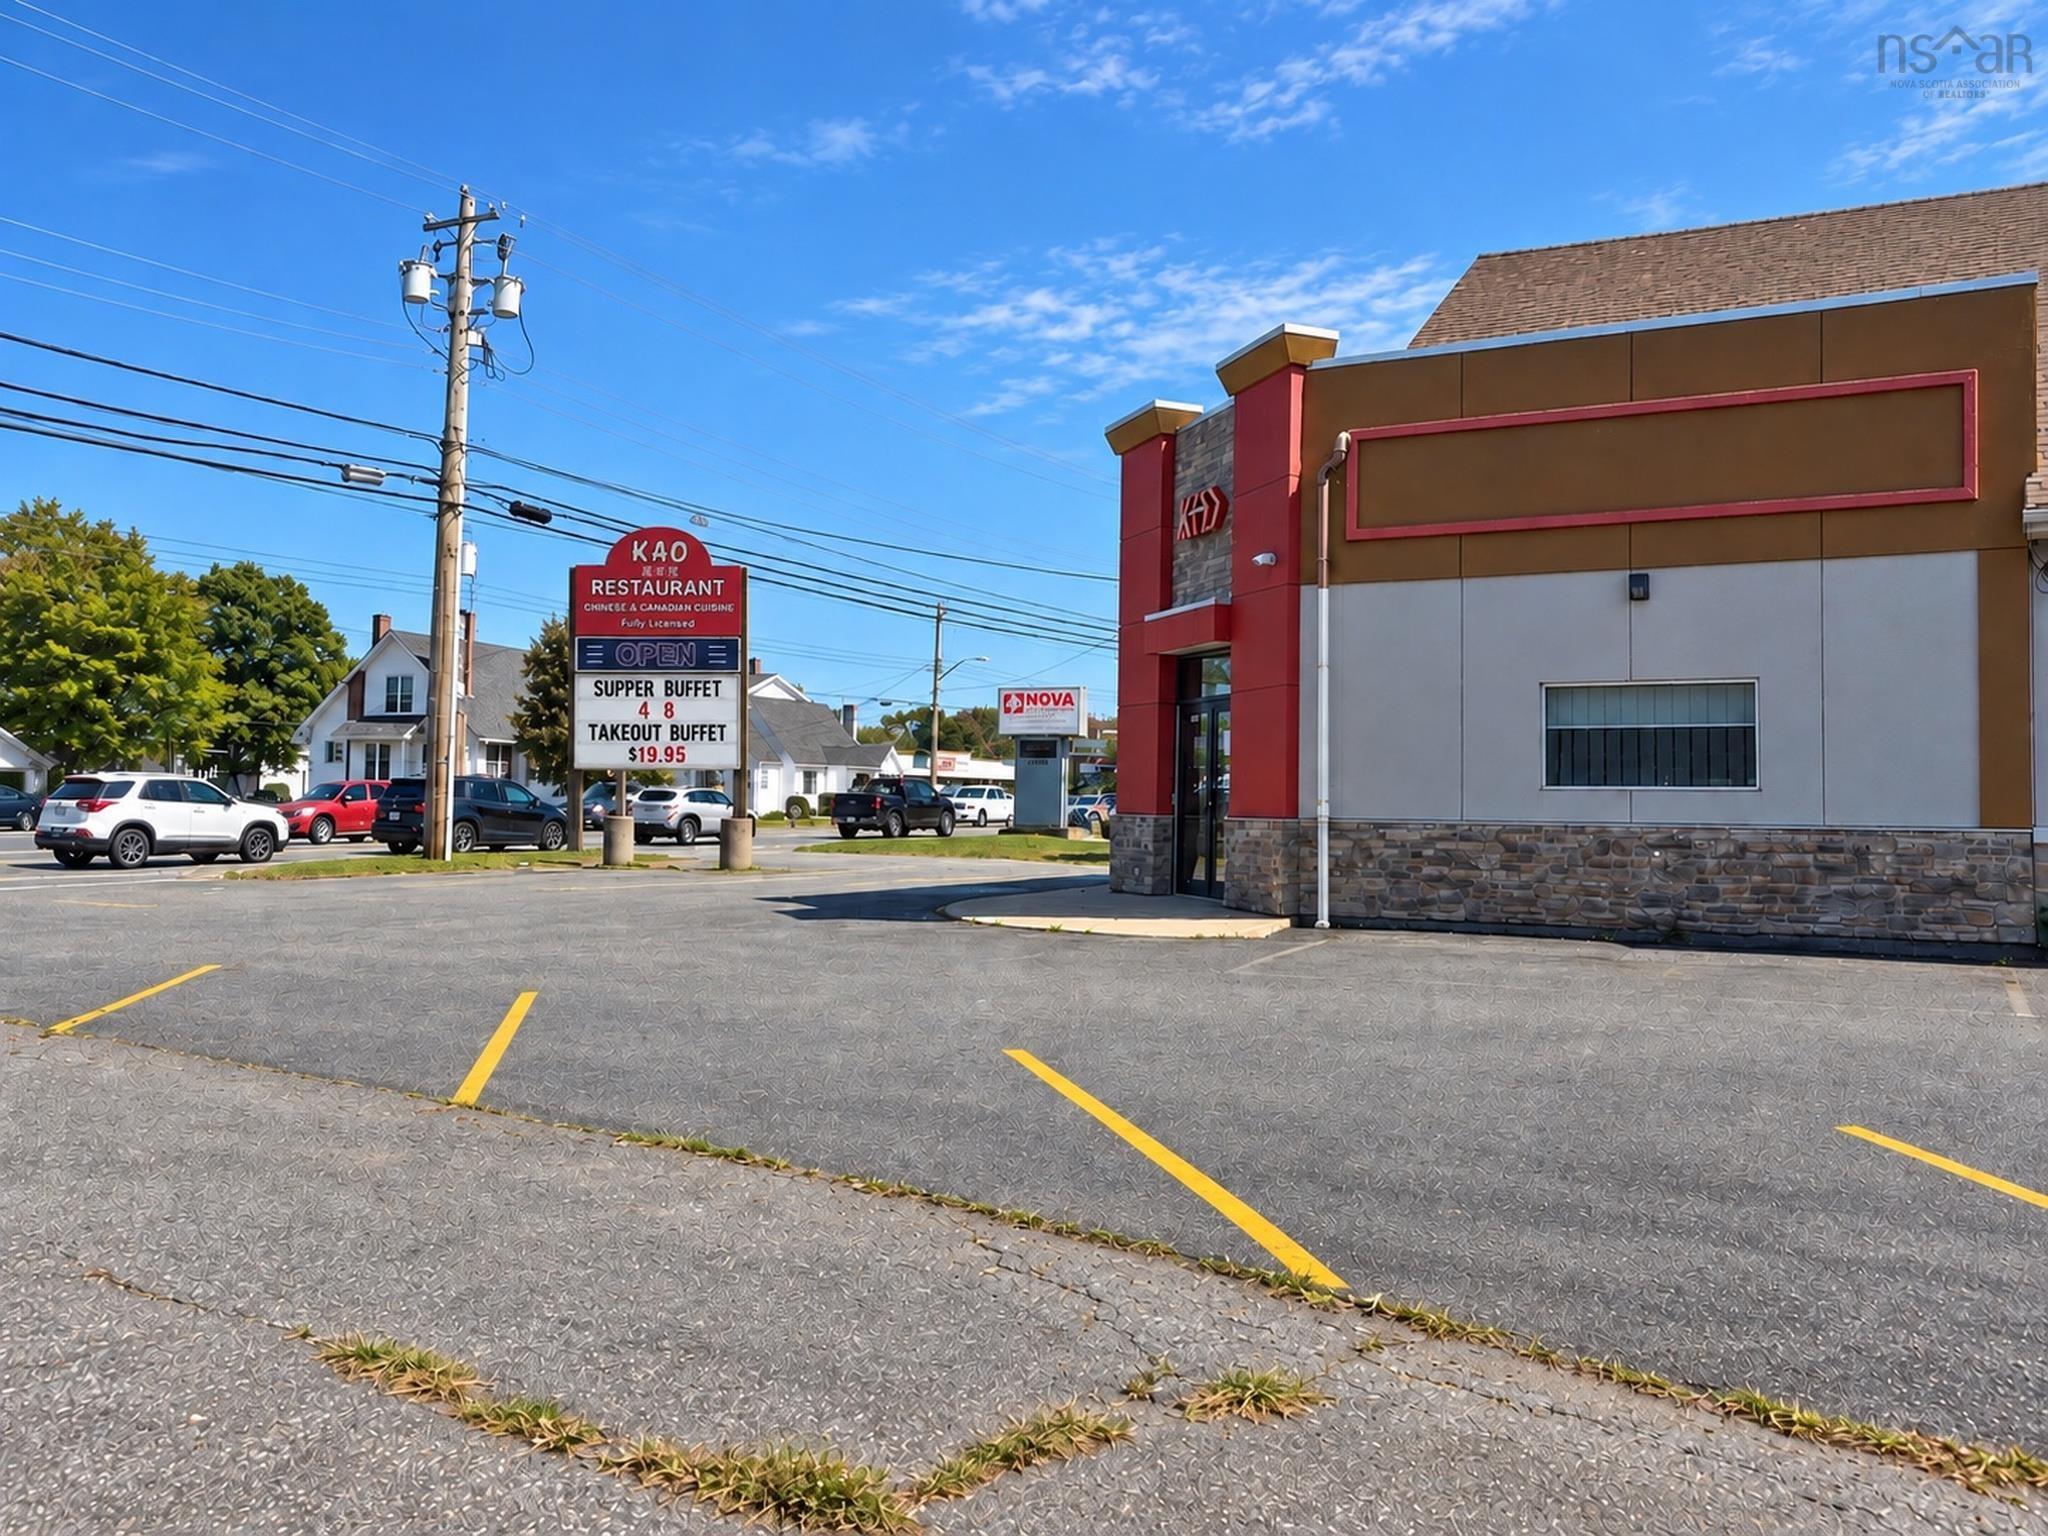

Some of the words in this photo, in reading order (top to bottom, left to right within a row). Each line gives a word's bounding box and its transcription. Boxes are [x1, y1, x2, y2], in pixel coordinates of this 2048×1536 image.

[632, 540, 688, 563] KAO
[591, 579, 725, 596] RESTAURANT
[584, 603, 626, 612] CHINESE
[629, 603, 637, 612] &
[640, 603, 691, 612] CANADIAN
[694, 603, 734, 612] CUISINE
[621, 618, 645, 629] Fully
[615, 642, 696, 667] OPEN
[594, 680, 654, 698] SUPPER
[664, 680, 722, 698] BUFFET
[1026, 692, 1074, 706] NOVA
[638, 701, 650, 719] 4
[664, 701, 675, 719] 8
[588, 724, 662, 742] TAKEOUT
[670, 724, 727, 742] BUFFET
[628, 746, 686, 763] $19.95
